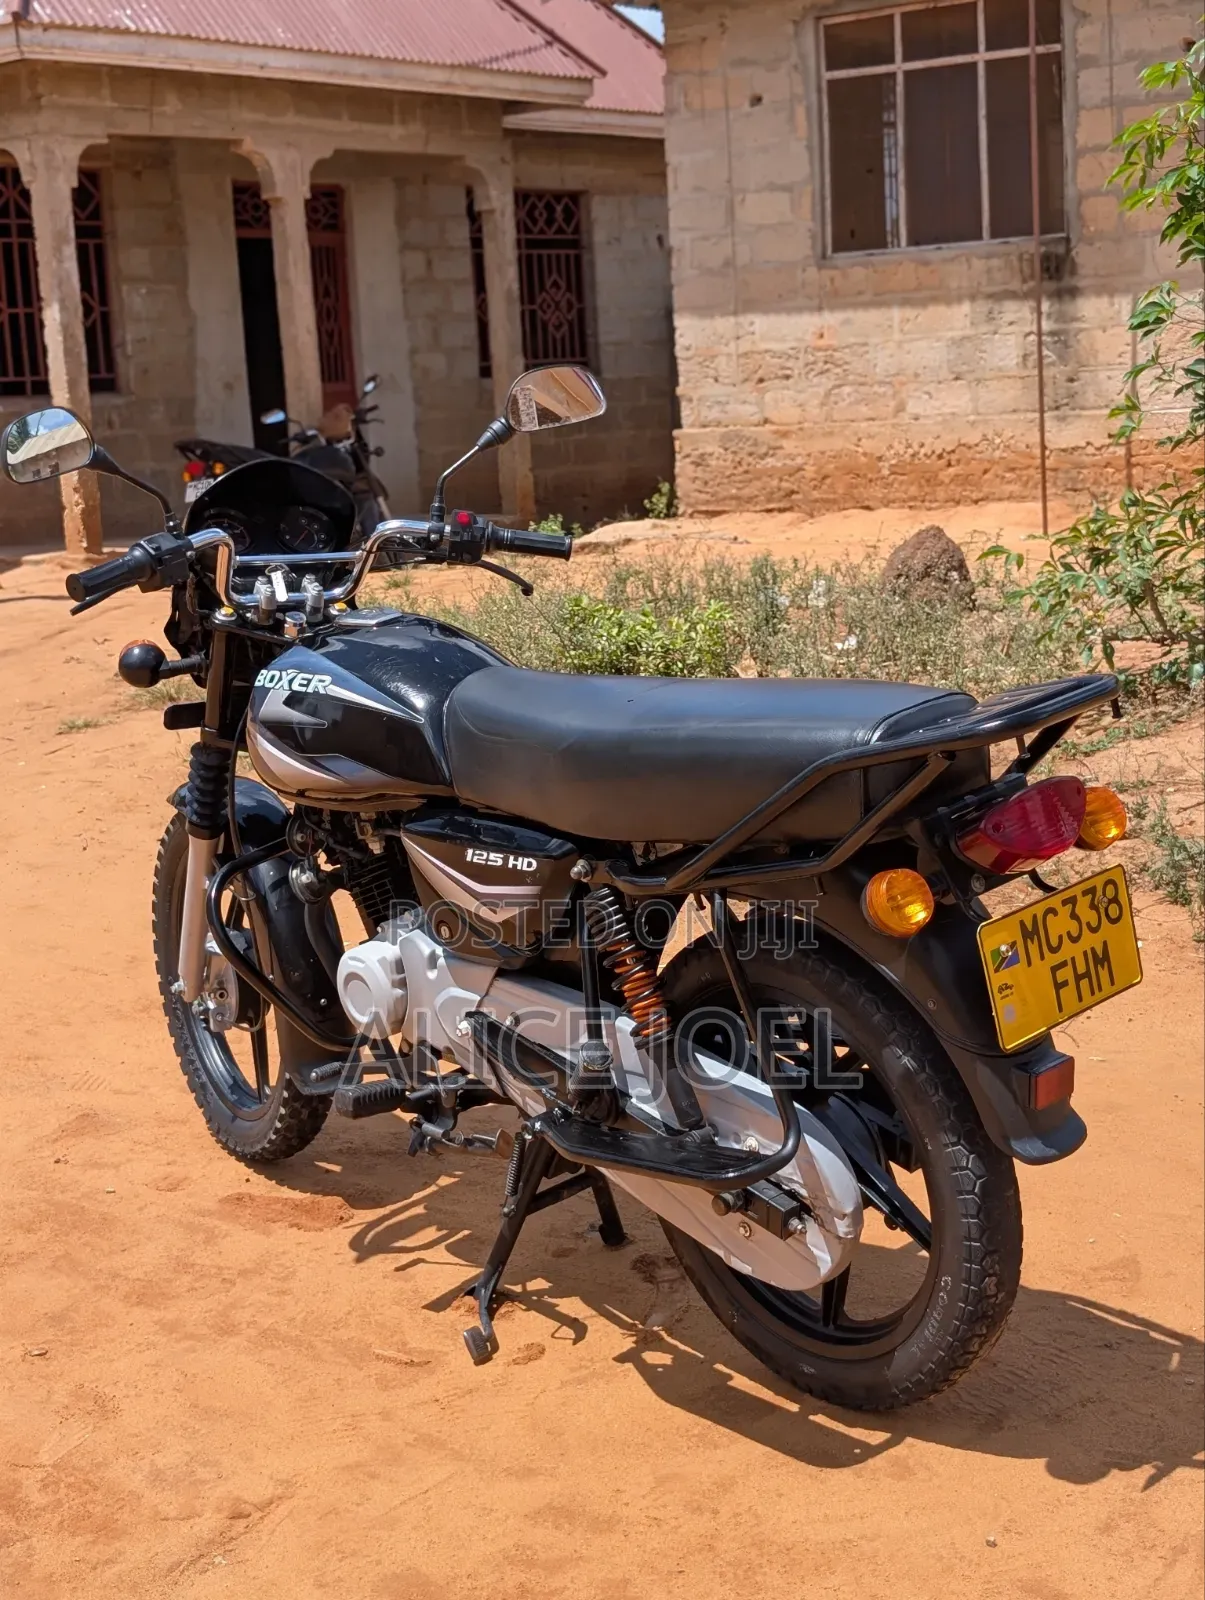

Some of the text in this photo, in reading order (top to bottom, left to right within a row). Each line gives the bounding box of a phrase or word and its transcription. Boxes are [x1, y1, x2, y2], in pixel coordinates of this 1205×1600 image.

[254, 669, 332, 694] BOXER
[465, 848, 537, 872] 125 HD
[1019, 878, 1123, 967] MC338
[1049, 940, 1115, 1013] FHM
